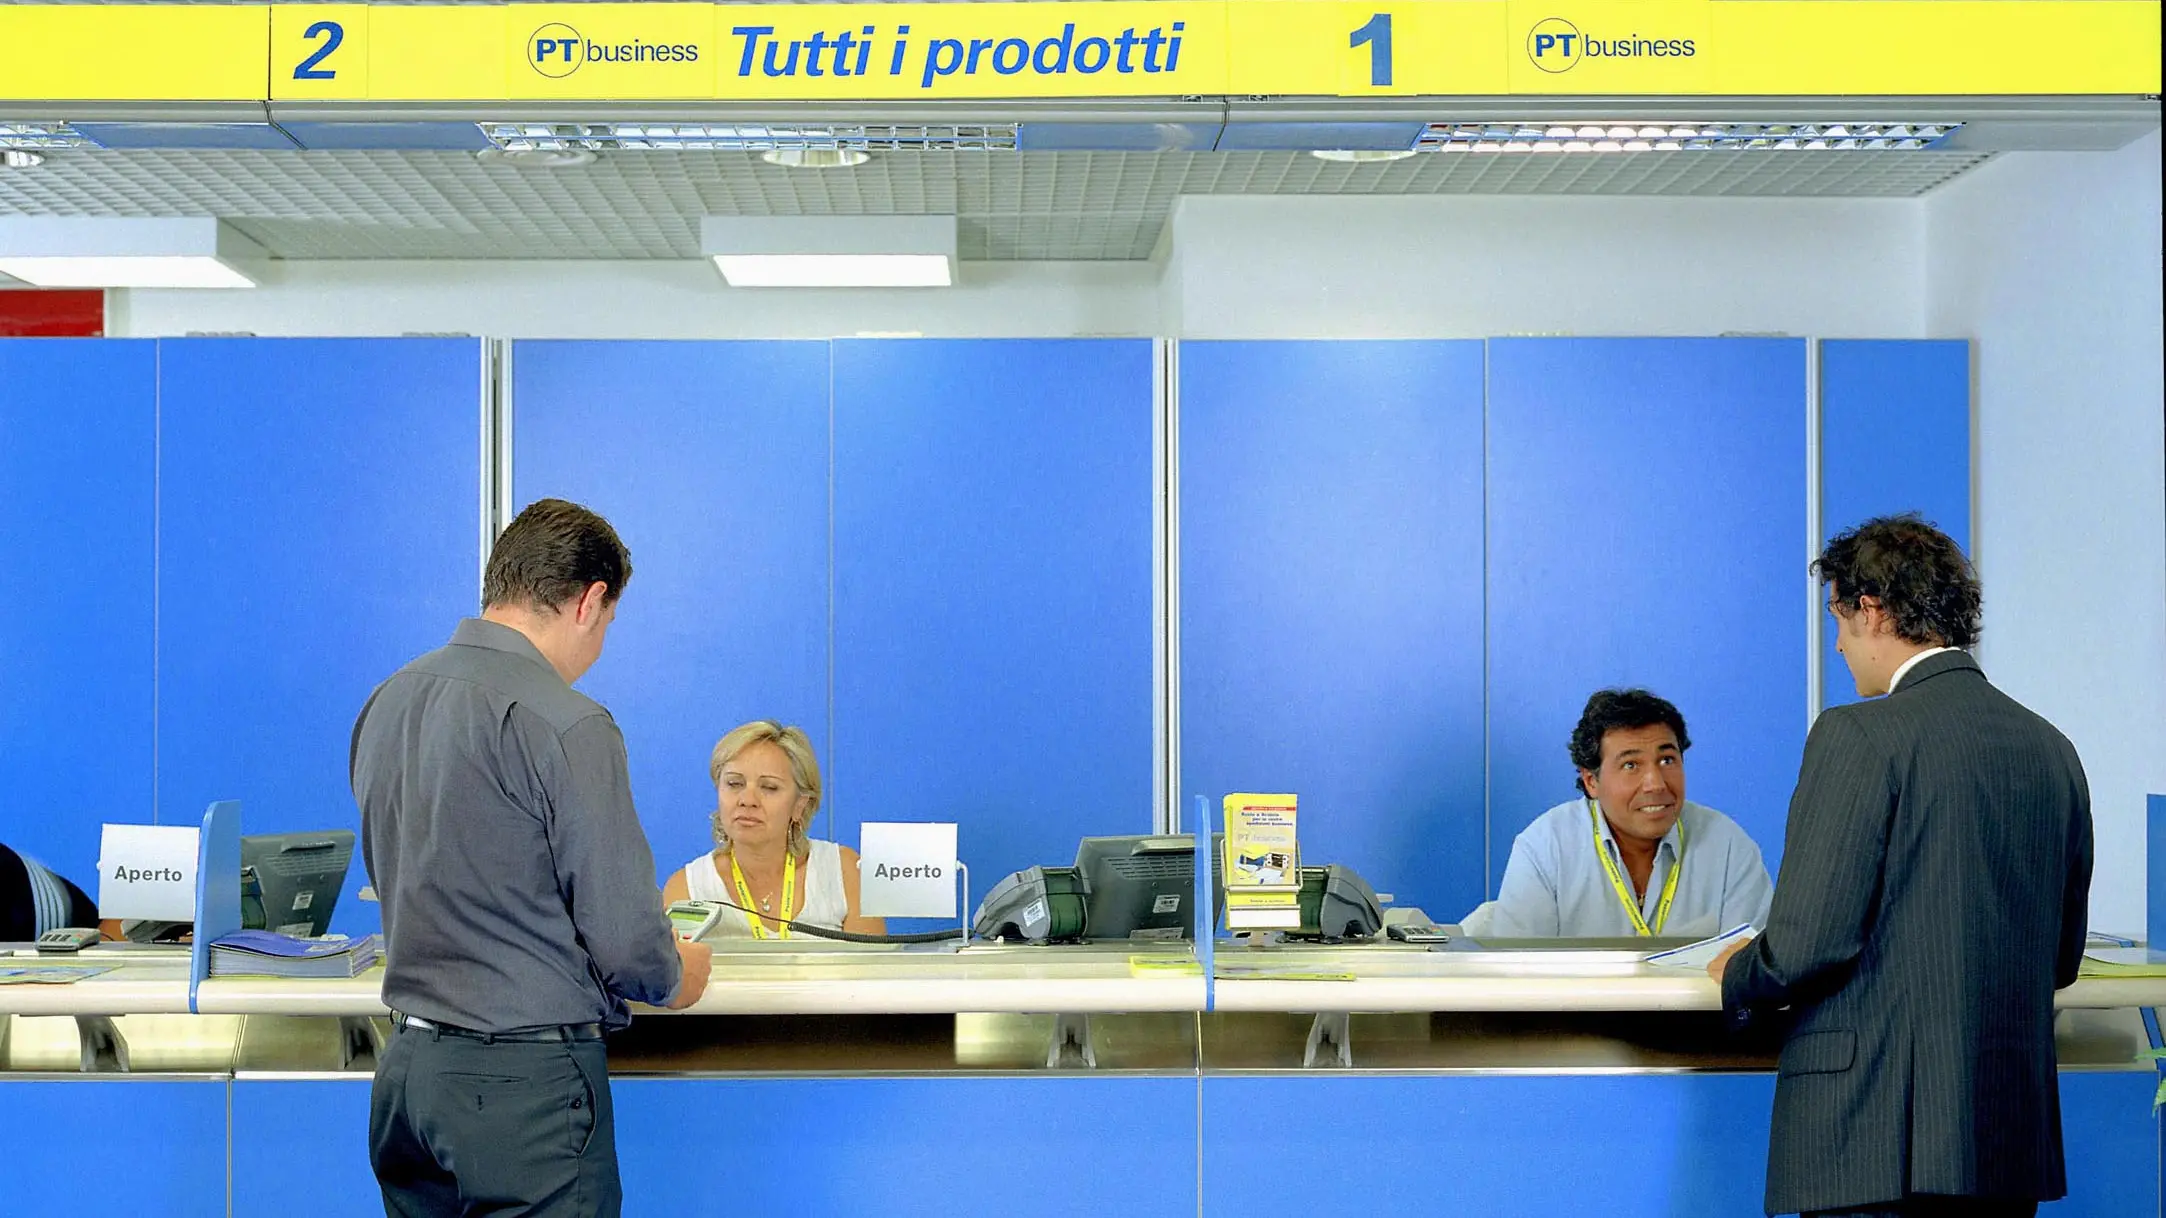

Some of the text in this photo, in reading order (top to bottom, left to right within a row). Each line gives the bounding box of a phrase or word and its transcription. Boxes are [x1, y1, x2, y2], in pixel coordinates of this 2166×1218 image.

[293, 21, 344, 80] 2
[536, 38, 699, 63] PT business
[731, 21, 1185, 89] Tutti i prodotti
[1349, 13, 1393, 86] 1
[1535, 33, 1696, 58] PT business
[114, 865, 183, 883] Aperto
[874, 863, 942, 880] Aperto
